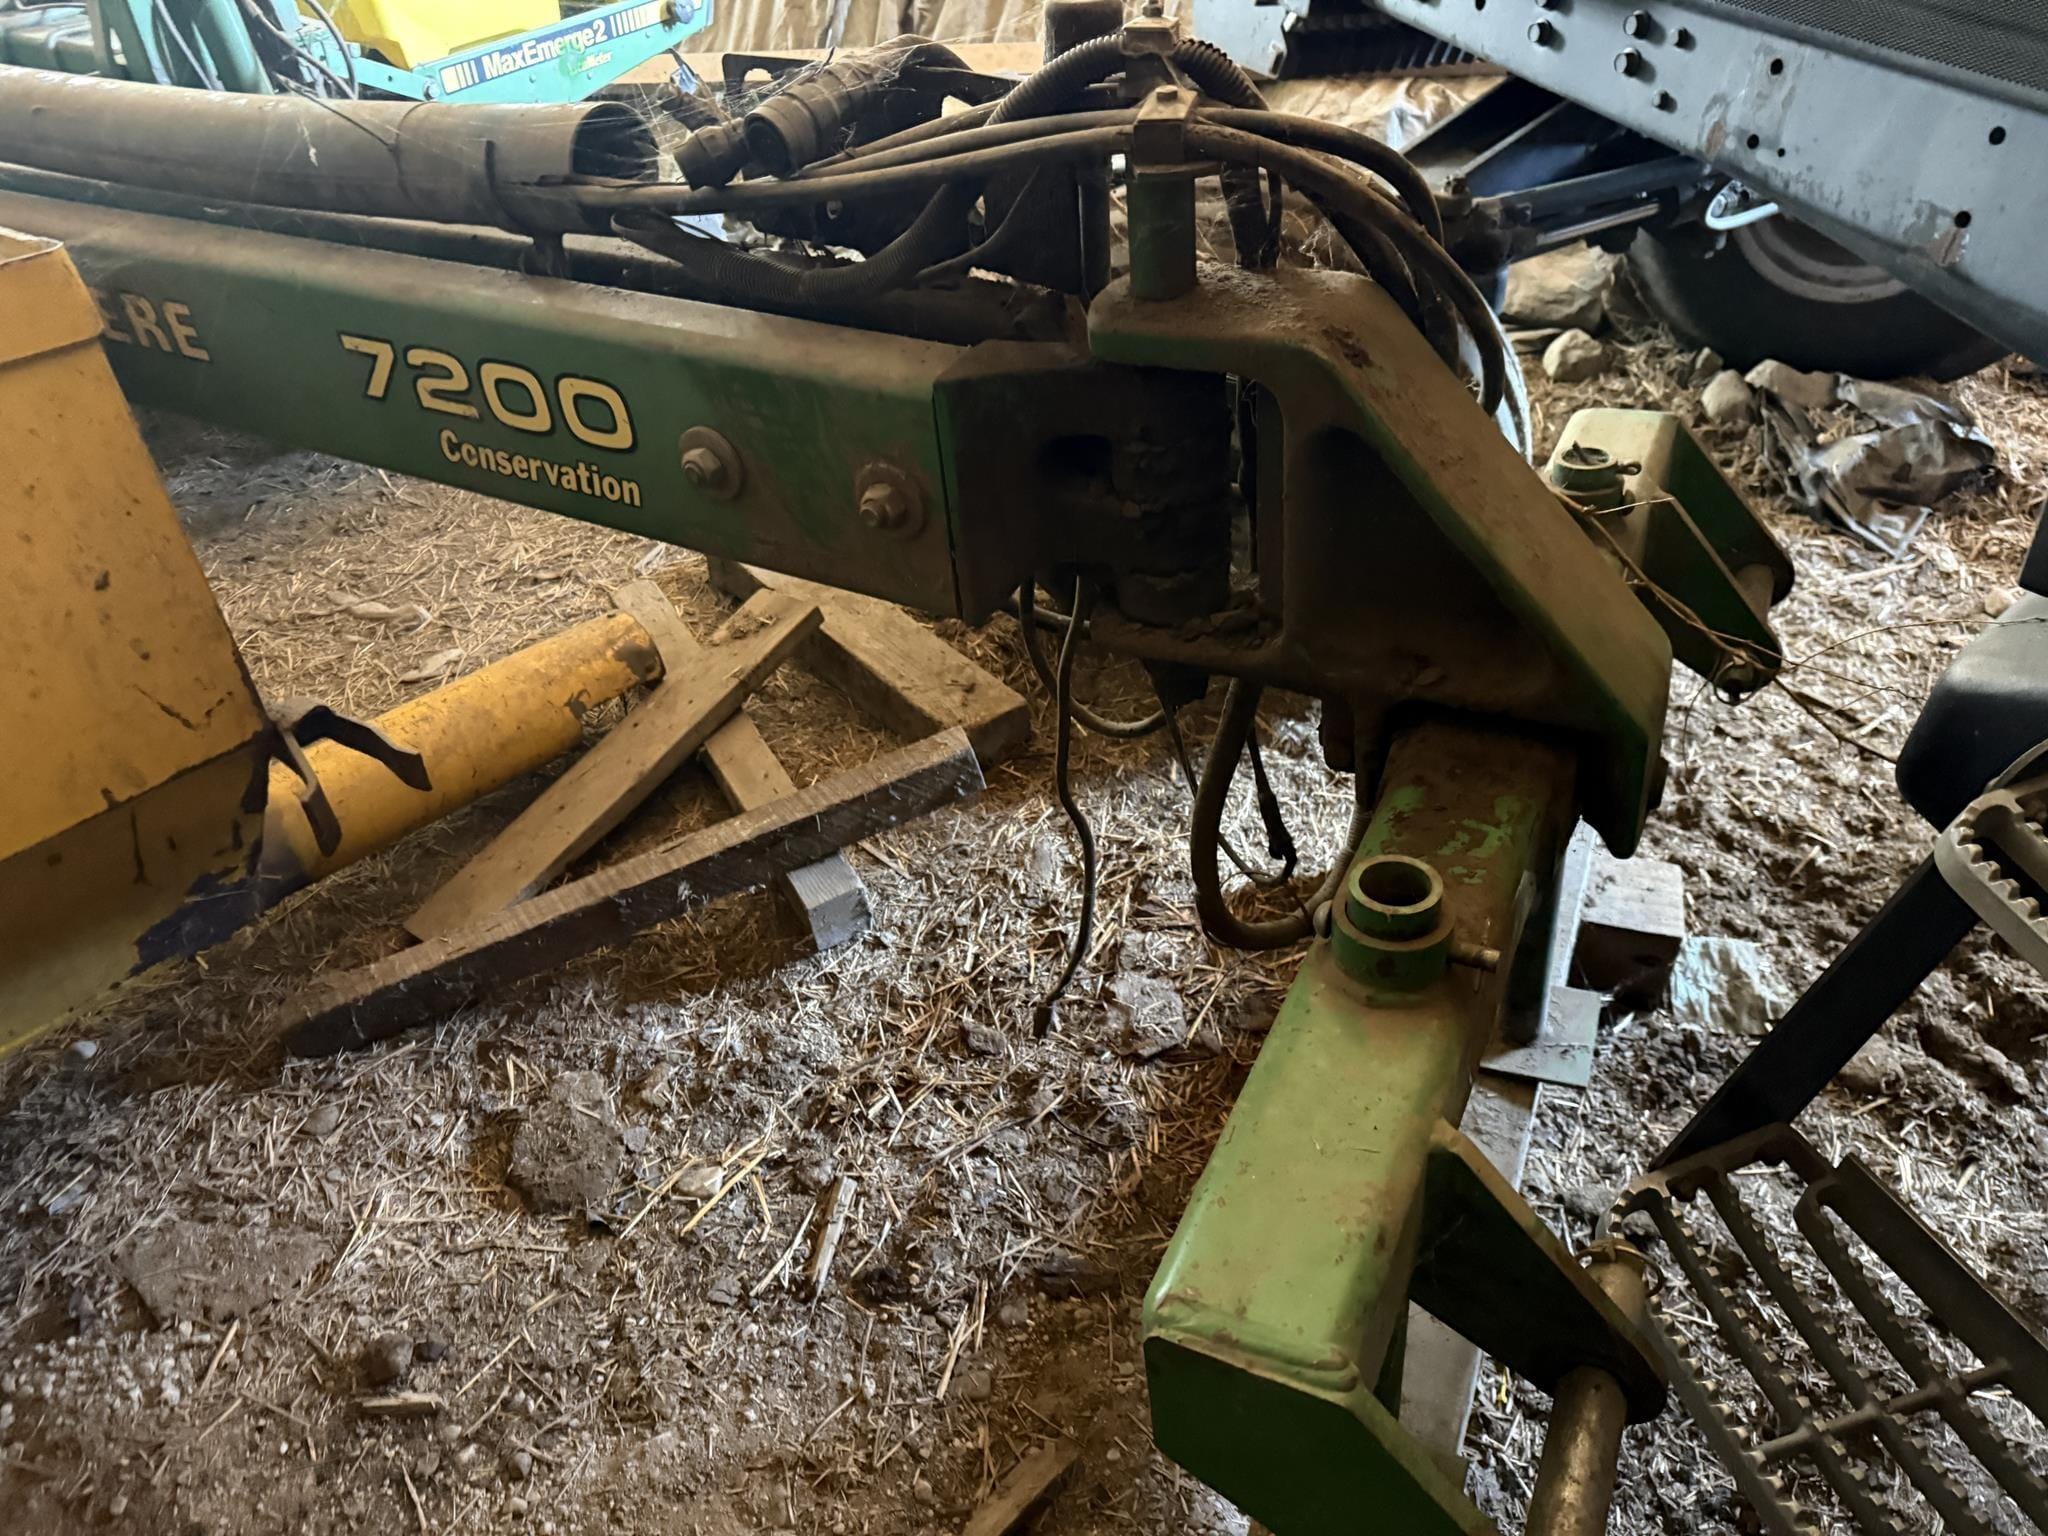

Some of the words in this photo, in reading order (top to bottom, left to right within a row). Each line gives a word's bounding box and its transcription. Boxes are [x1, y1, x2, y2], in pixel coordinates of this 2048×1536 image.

[481, 19, 608, 80] MaxEmerge2
[340, 334, 634, 450] 7200
[440, 428, 641, 507] Conservation
